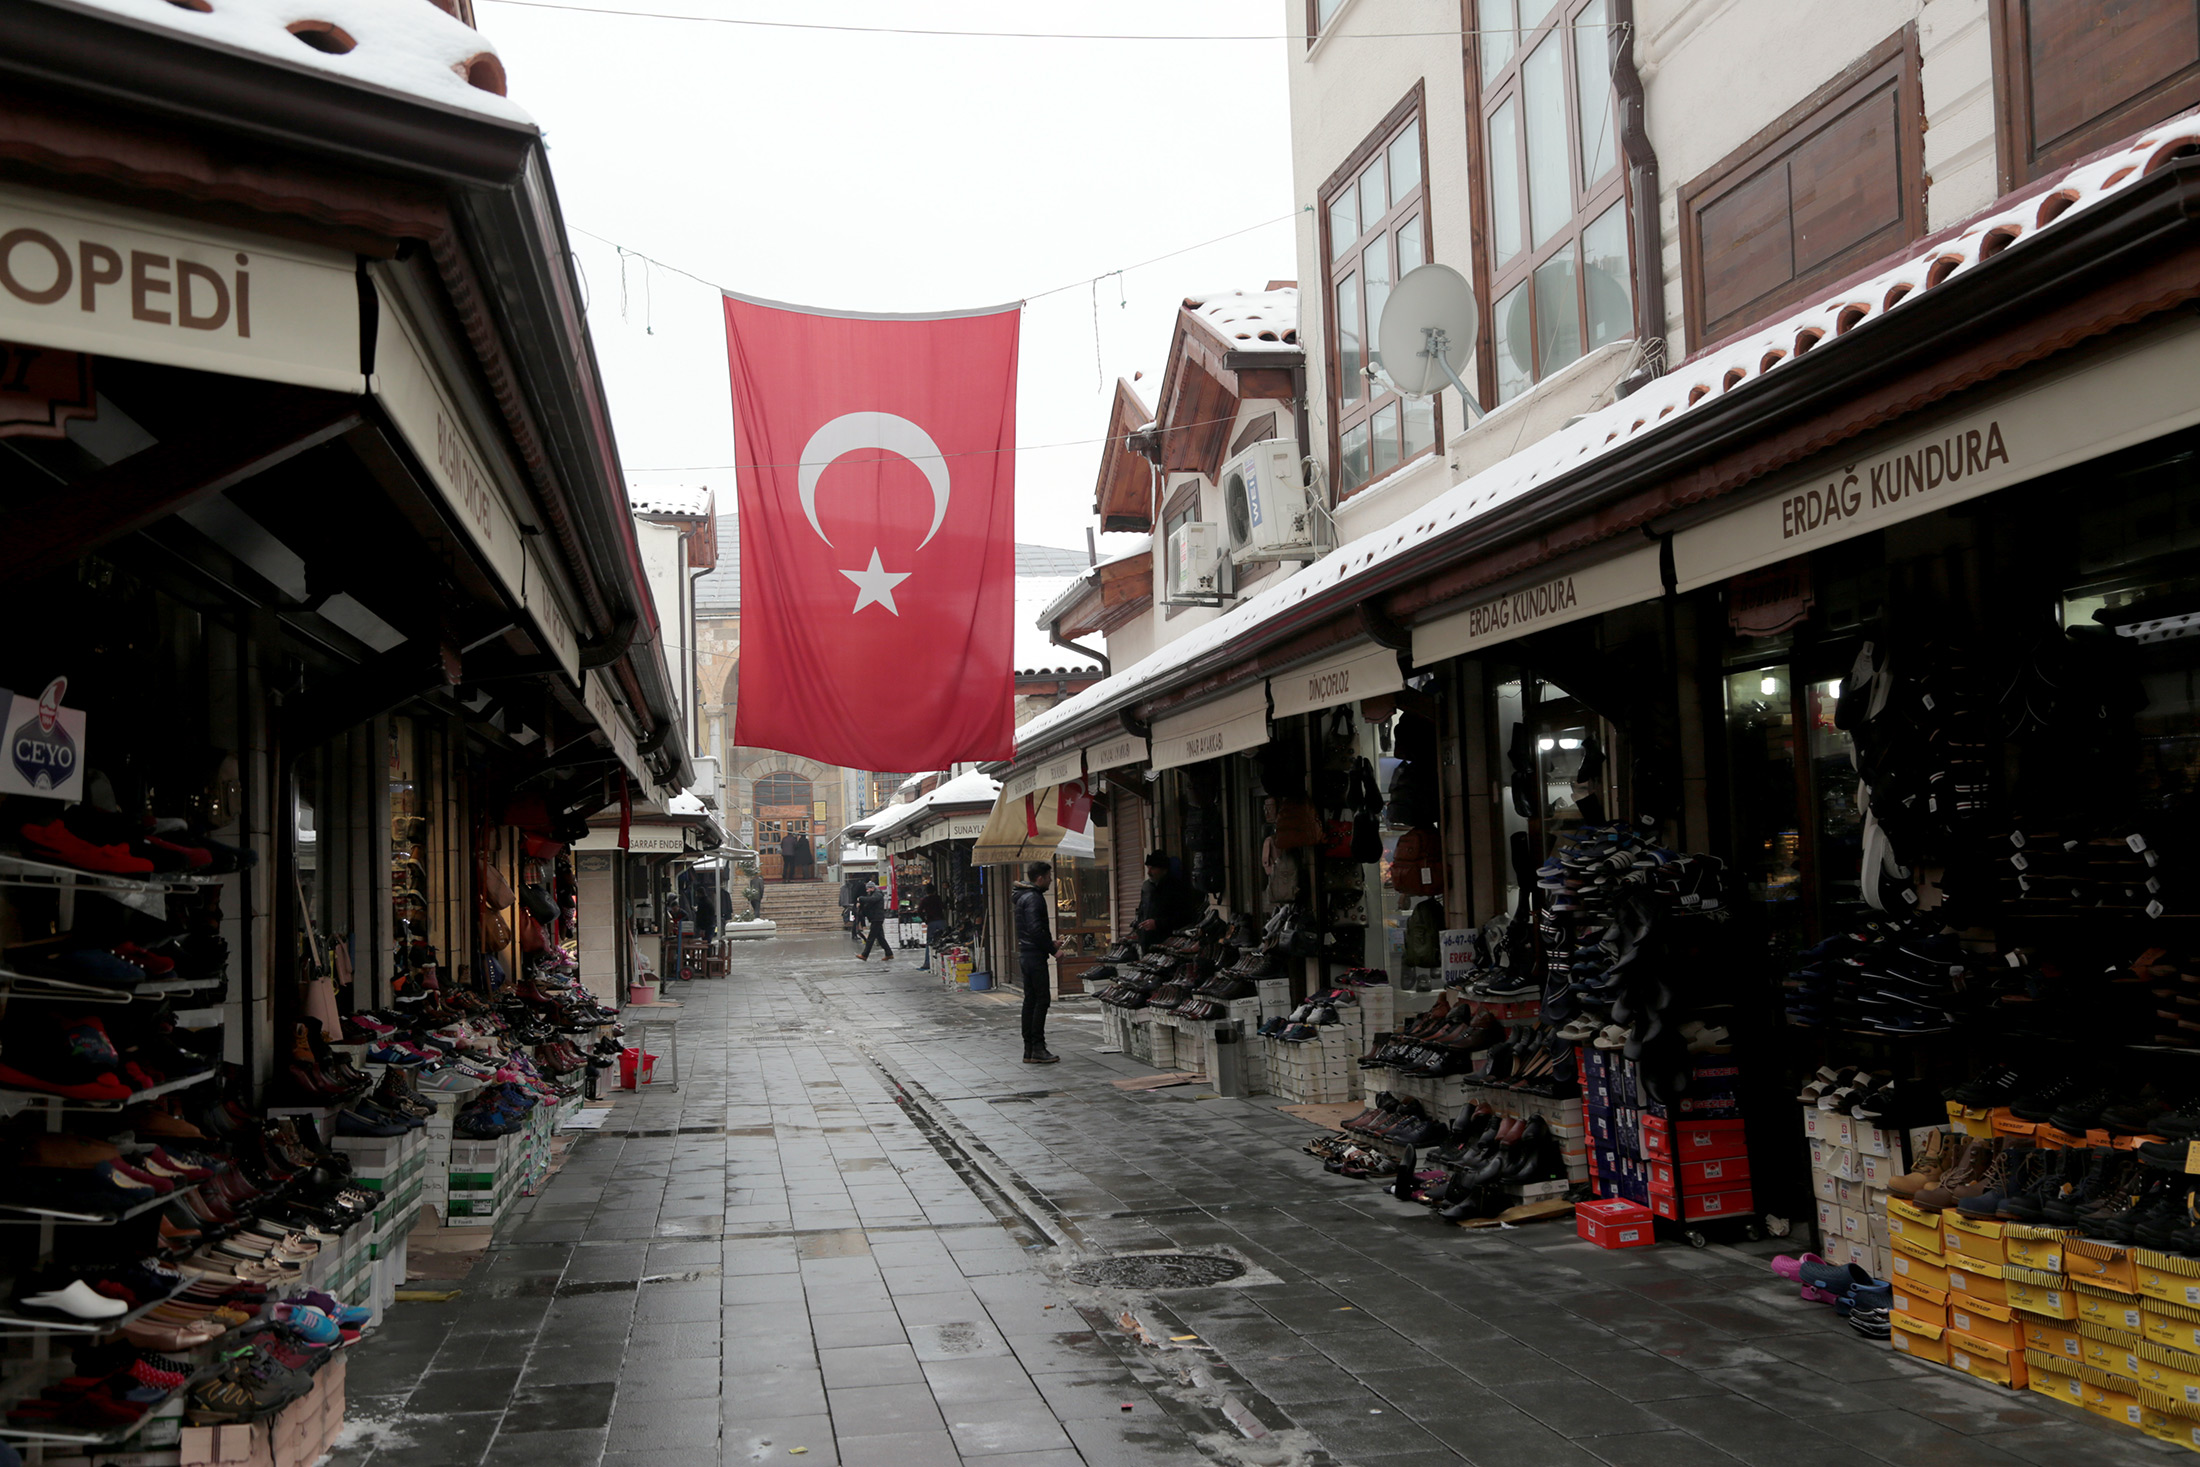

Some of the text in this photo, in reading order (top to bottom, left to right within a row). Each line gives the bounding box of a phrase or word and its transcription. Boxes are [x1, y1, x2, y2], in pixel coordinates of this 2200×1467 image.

[1782, 420, 2010, 540] ERDAĞ KUNDURA
[1512, 576, 1577, 625] KUNDURA
[16, 738, 73, 768] CEYO
[630, 839, 683, 849] SARRAF ENDER
[1449, 952, 1472, 964] ERKEK
[1696, 1067, 1740, 1078] GEZER
[1694, 1099, 1736, 1109] GEZER
